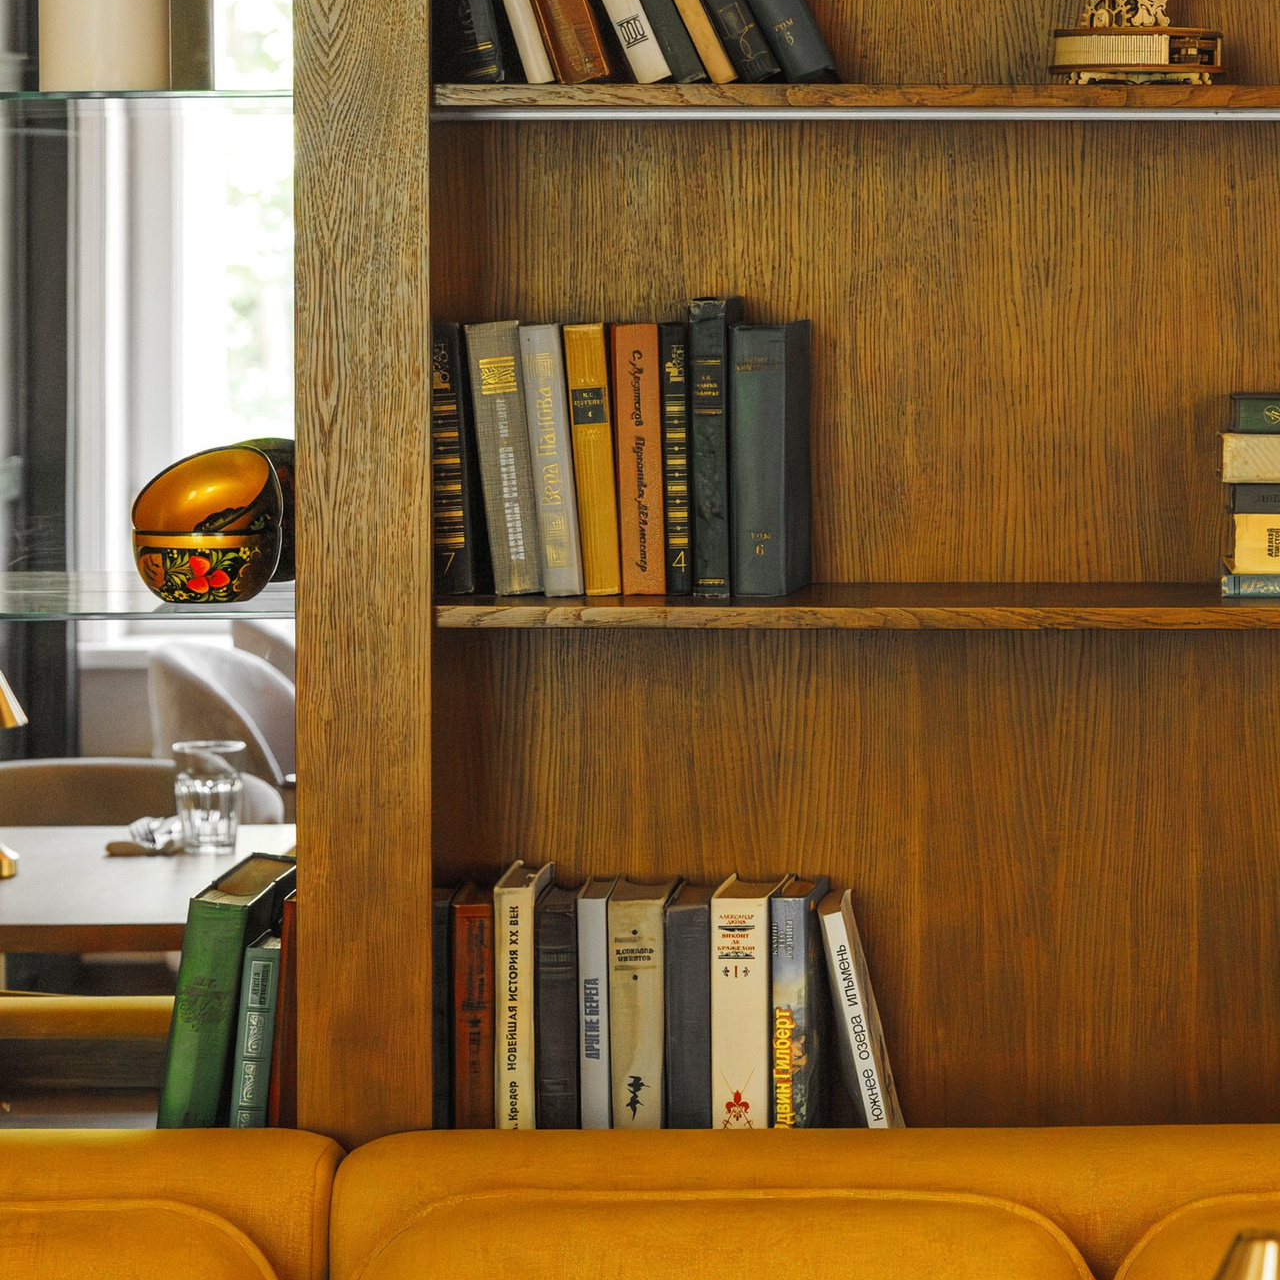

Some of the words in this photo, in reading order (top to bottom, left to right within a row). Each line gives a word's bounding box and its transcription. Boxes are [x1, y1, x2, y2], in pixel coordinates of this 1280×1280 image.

[536, 384, 557, 457] Панова
[500, 446, 516, 500] СТЕПАНОВ
[541, 464, 562, 507] Вера
[505, 500, 525, 561] АЛЕКСАНДР
[442, 552, 456, 574] 7
[673, 551, 687, 573] 4
[509, 949, 519, 1003] ИСТОРИЯ
[583, 977, 600, 1020] БЕРЕГА
[835, 943, 861, 1008] ильмень
[508, 1005, 519, 1071] НОВЕЙШАЯ
[584, 1020, 600, 1061] ДРУГИЕ
[773, 1008, 795, 1071] Гилберт
[853, 1014, 873, 1062] озера
[508, 1080, 519, 1122] Кредер
[861, 1067, 884, 1122] южнее
